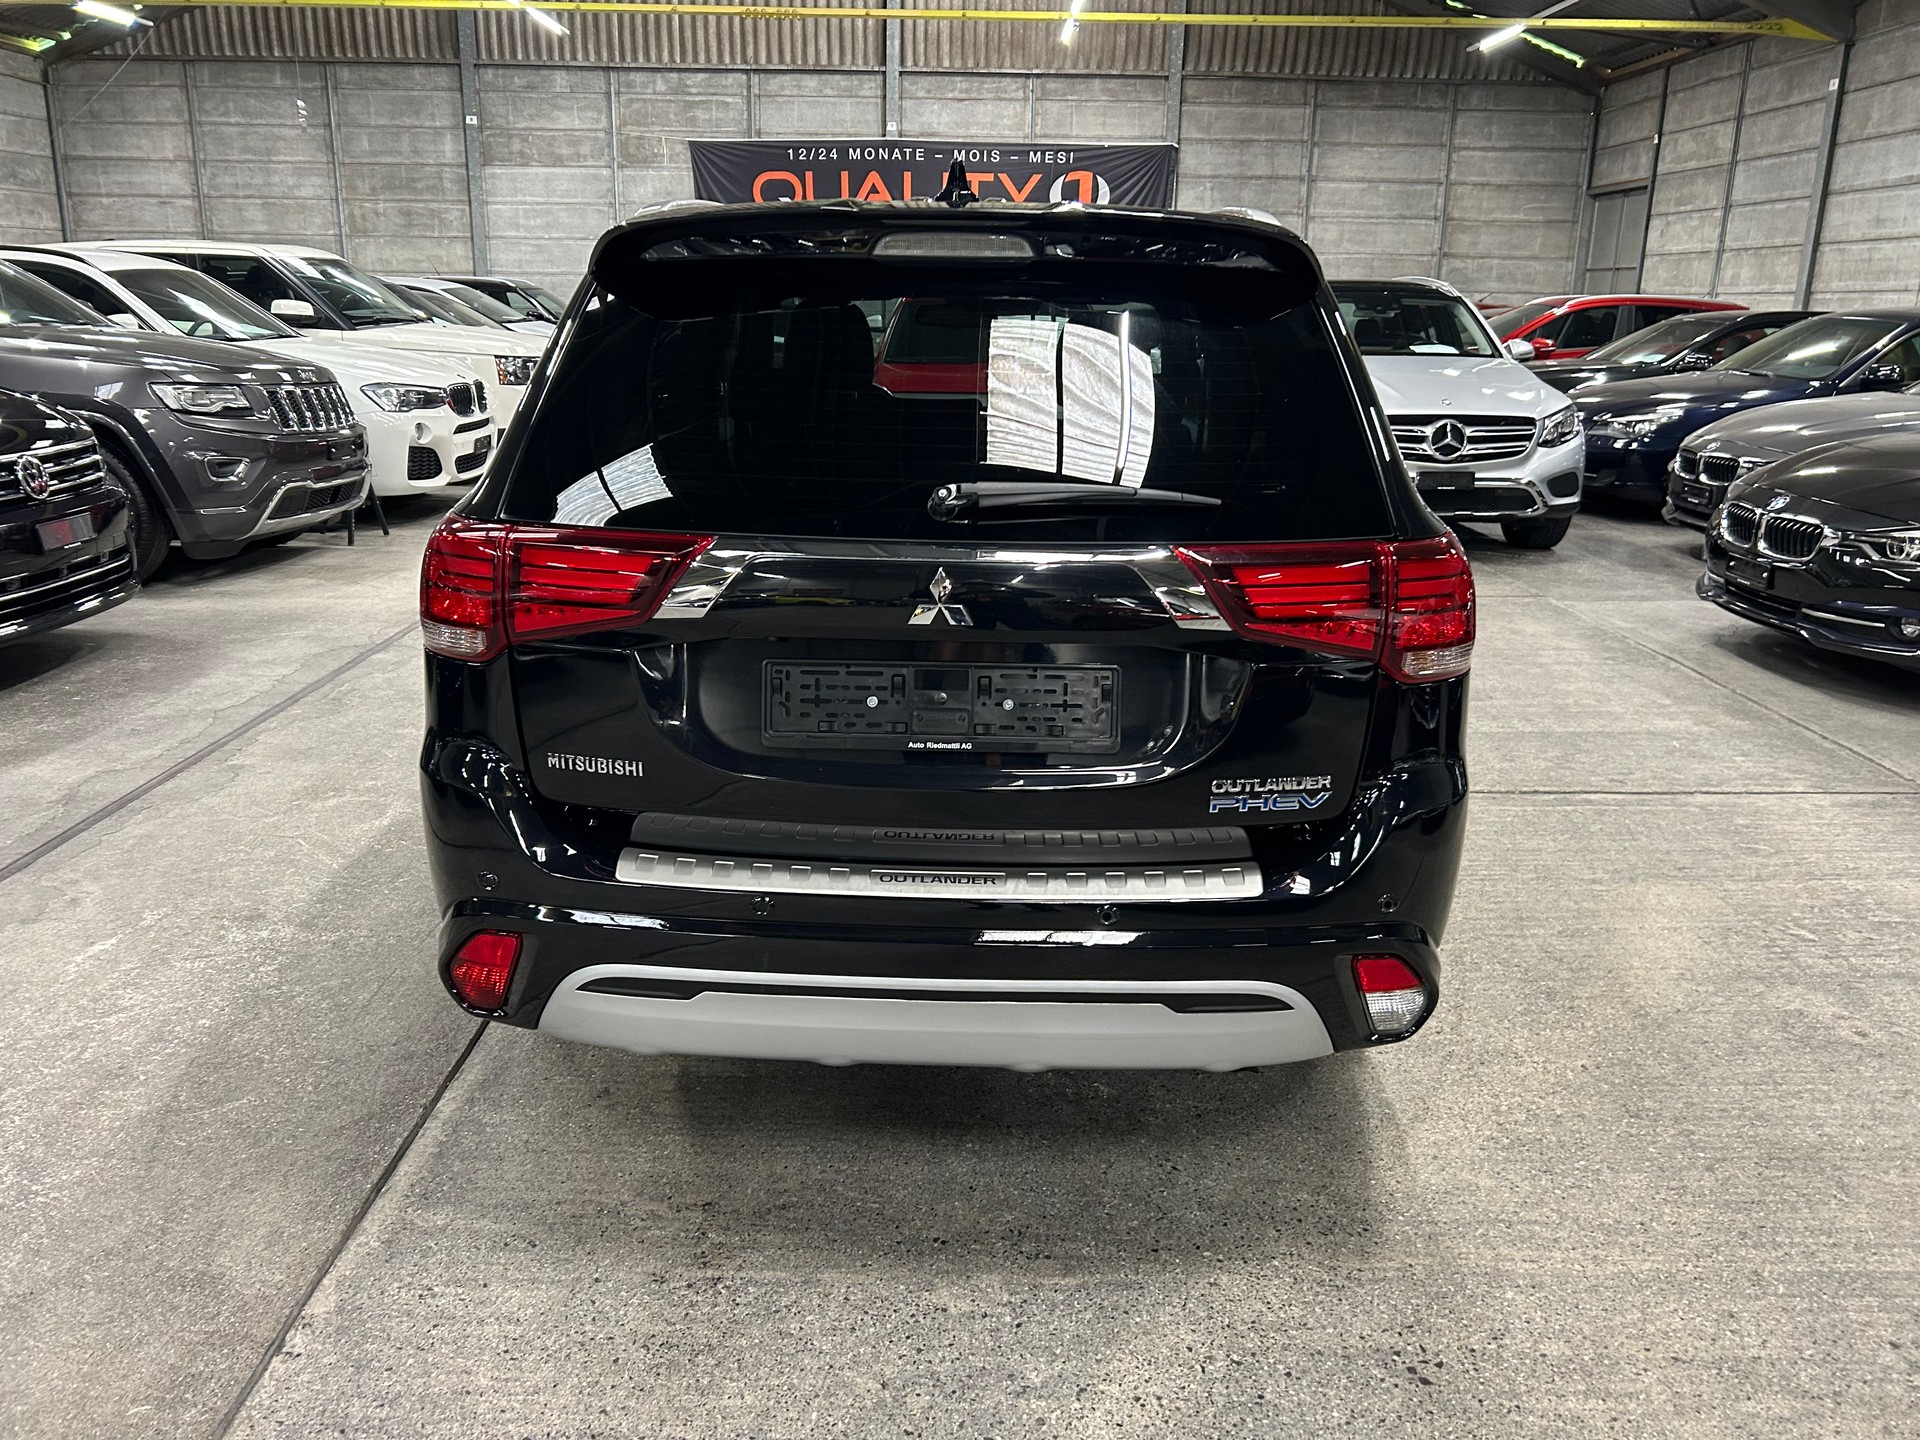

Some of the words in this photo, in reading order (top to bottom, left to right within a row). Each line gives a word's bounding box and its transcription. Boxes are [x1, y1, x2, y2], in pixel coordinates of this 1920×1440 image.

[787, 148, 838, 160] 12/24
[849, 148, 925, 160] MONATE
[953, 149, 1000, 162] MOIS
[1029, 151, 1074, 164] MESI
[908, 741, 925, 749] Auto
[961, 742, 973, 750] AG
[547, 752, 644, 777] MITSUBISHI
[1211, 775, 1332, 793] OUTLANDER
[1209, 791, 1333, 813] PHEV
[879, 874, 997, 885] OUTLANDER
